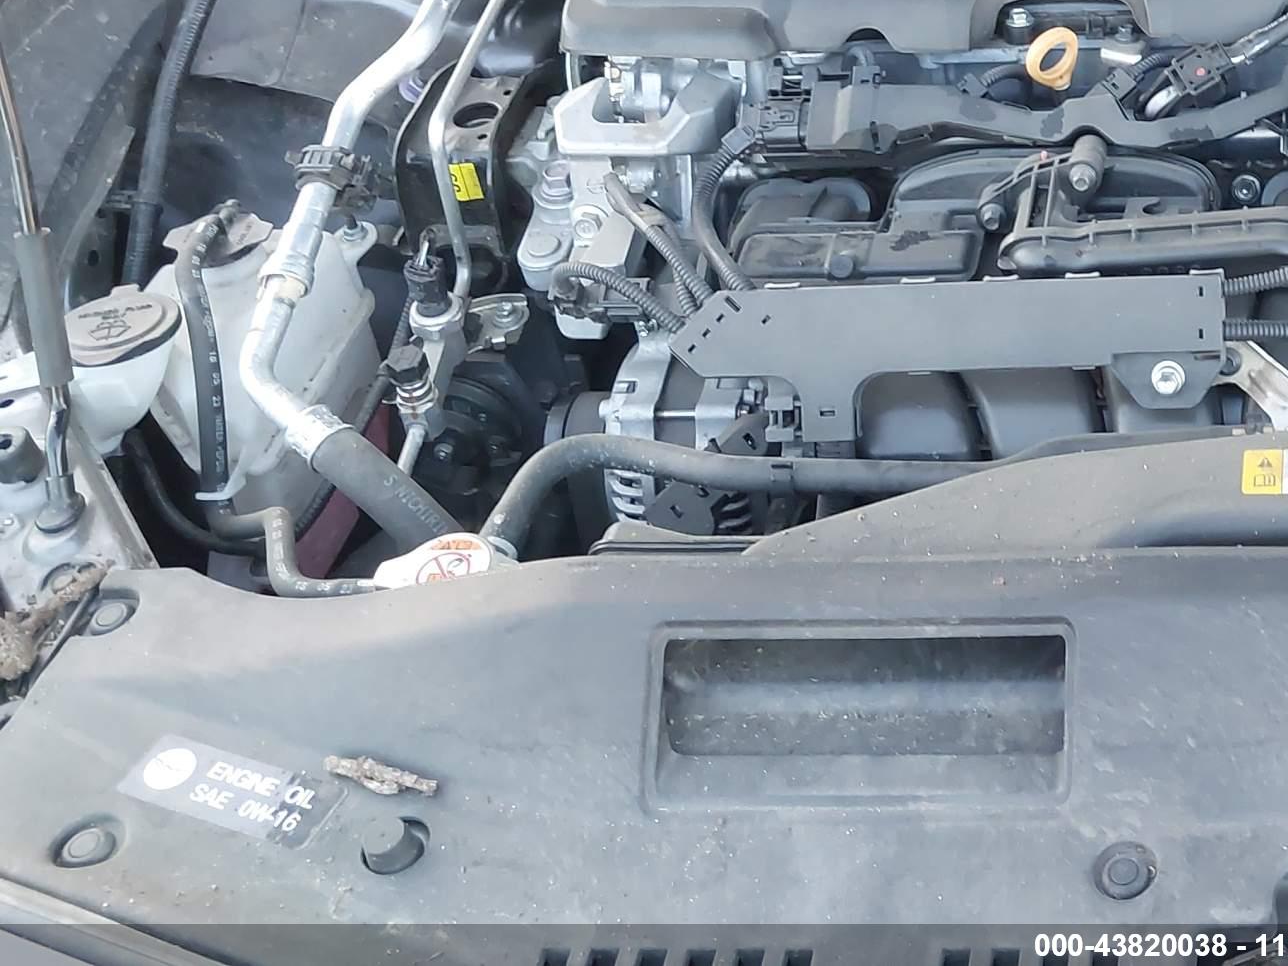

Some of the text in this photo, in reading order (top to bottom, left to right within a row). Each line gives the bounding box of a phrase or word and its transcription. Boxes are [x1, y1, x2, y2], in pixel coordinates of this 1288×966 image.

[189, 783, 301, 832] SAE 0W-16
[206, 761, 281, 797] ENGINE
[284, 785, 316, 810] OIL
